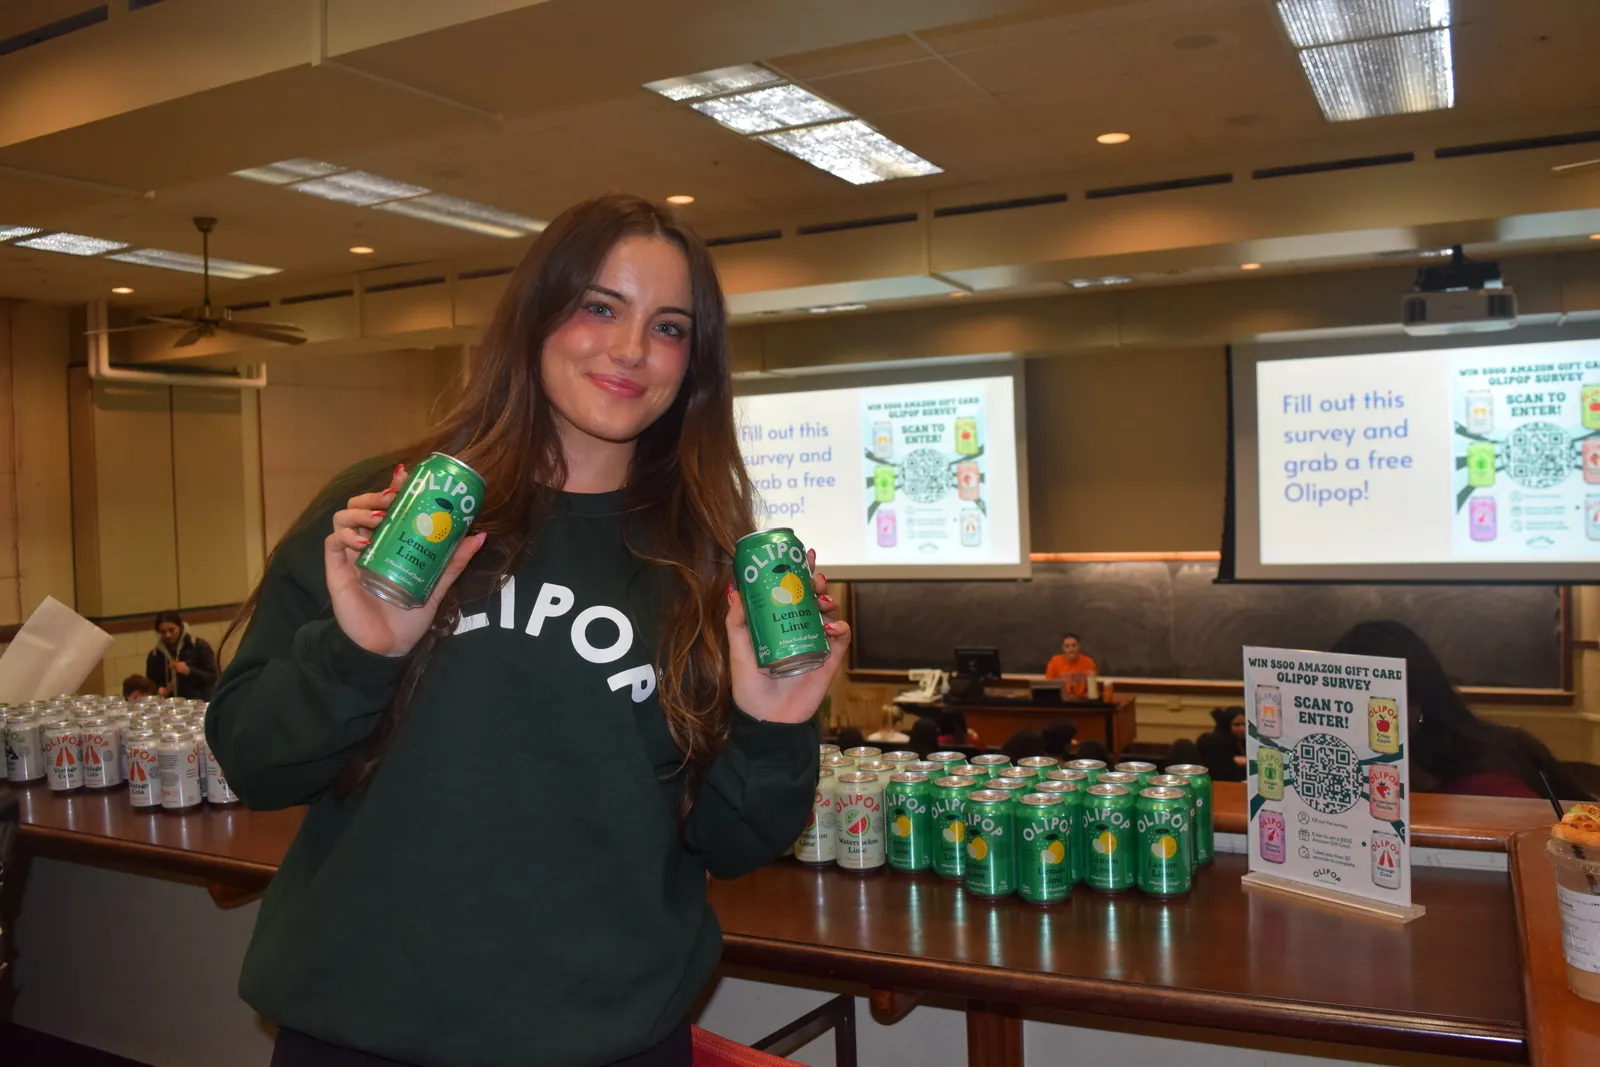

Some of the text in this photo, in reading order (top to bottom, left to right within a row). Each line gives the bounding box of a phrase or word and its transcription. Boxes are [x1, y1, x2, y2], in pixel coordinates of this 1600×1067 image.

[1584, 360, 1600, 369] CA
[1488, 372, 1584, 386] OLIPOP SURVEY
[1283, 390, 1405, 414] Fill out this
[1506, 391, 1566, 404] SCAN TO
[741, 421, 830, 441] Fill out this
[1284, 418, 1409, 448] survey and
[743, 445, 832, 469] survey and
[1284, 449, 1413, 479] grab a free
[752, 471, 836, 490] rab a free
[1284, 479, 1370, 507] Olipop!
[398, 530, 438, 562] Lemon
[396, 545, 426, 570] Lime
[772, 608, 812, 623] Lemon
[780, 621, 810, 634] Lime
[453, 574, 657, 703] IPOP
[1248, 657, 1402, 680] WIN $500 AMAZON GIFT CARD
[1276, 672, 1372, 691] OLIPOP SURVEY
[1294, 696, 1354, 714] SCAN TO
[1298, 711, 1349, 729] ENTER!
[45, 735, 84, 752] OLIPOP
[83, 734, 109, 748] IPOP
[126, 747, 157, 763] LIPOP
[836, 792, 880, 814] OLIPOP
[887, 793, 926, 814] LIPOP
[931, 799, 965, 819] OLIP
[965, 813, 1004, 836] LIPOP
[1137, 811, 1189, 833] OLIPOP
[838, 837, 878, 847] Watermelon
[1313, 868, 1341, 882] OLIPOP
